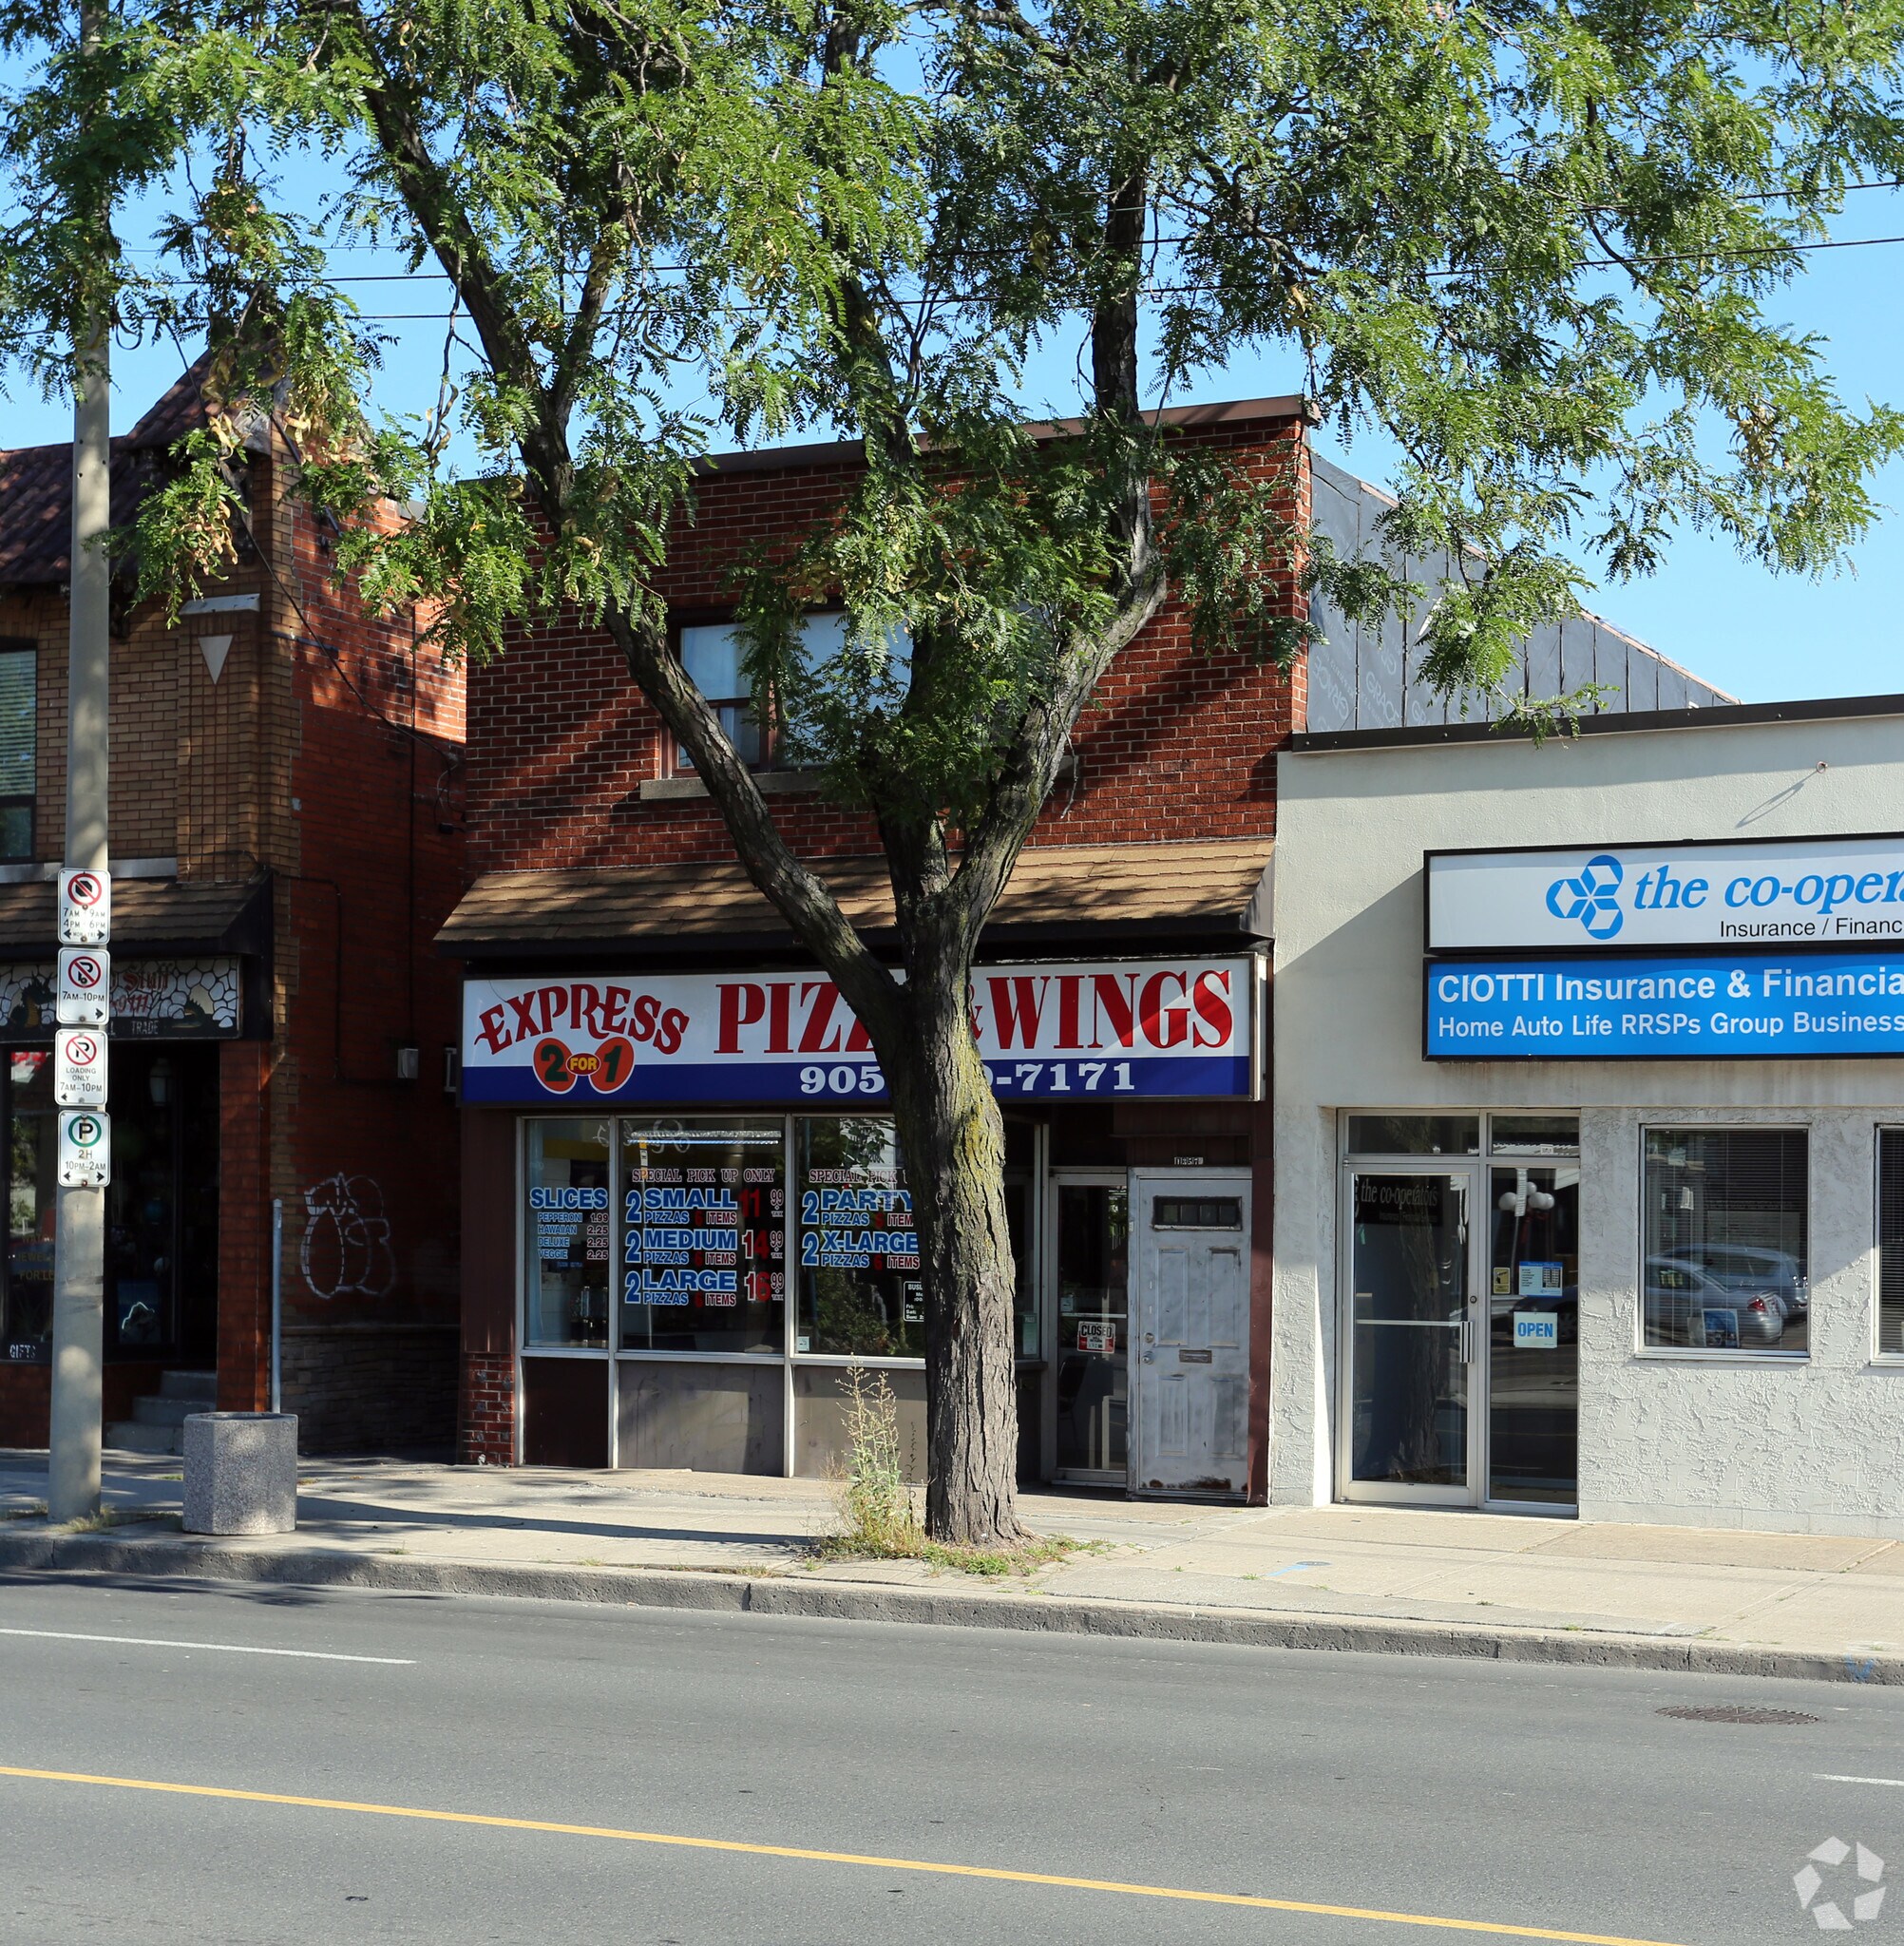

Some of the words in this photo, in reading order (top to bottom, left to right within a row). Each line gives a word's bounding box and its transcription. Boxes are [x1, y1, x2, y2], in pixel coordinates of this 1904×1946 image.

[1633, 865, 1708, 909] the
[63, 907, 80, 917] 7AM
[63, 918, 81, 927] 4PM
[1719, 920, 1816, 938] Insurance
[1819, 919, 1830, 935] /
[1438, 973, 1544, 1003] CIOTTI
[1556, 973, 1715, 1002] Insurance
[1726, 969, 1752, 999] &
[62, 990, 105, 1002] 7AM-10PM
[473, 983, 690, 1056] EXPRESS
[714, 981, 874, 1054] PIZ
[986, 969, 1233, 1050] WINGS
[131, 1020, 160, 1035] TRADE
[1438, 1016, 1504, 1038] Home
[1511, 1016, 1564, 1038] Auto
[1572, 1015, 1612, 1037] Life
[1621, 1013, 1701, 1036] RRSPs
[1710, 1012, 1784, 1039] Group
[1793, 1010, 1904, 1033] Business
[540, 1043, 569, 1082] 2
[570, 1057, 598, 1071] FOR
[604, 1044, 623, 1083] 1
[60, 1082, 103, 1093] 7AM-10PM
[799, 1065, 885, 1094] 905
[632, 1168, 683, 1183] SPECIAL
[686, 1168, 715, 1183] PICK
[720, 1168, 739, 1183] UP
[743, 1168, 775, 1183] ONLY
[809, 1169, 862, 1183] SPECIAL
[867, 1169, 898, 1183] PICK
[1361, 1177, 1378, 1203] the
[529, 1187, 608, 1210] SLICES
[625, 1190, 642, 1223] 2
[643, 1188, 738, 1210] SMALL
[738, 1189, 760, 1218] 11
[770, 1189, 784, 1207] 99
[802, 1190, 819, 1225] 2
[820, 1189, 912, 1211] PARTY
[538, 1211, 583, 1223] PEPPERONI
[590, 1212, 608, 1223] 1.99
[643, 1210, 690, 1225] PIZZAS
[706, 1211, 737, 1225] ITEMS
[821, 1211, 869, 1226] PIZZAS
[887, 1212, 914, 1227] ITEM
[538, 1224, 578, 1234] HAWAIIAN
[587, 1226, 608, 1235] 2.25
[538, 1236, 570, 1247] DELUXE
[587, 1237, 608, 1248] 2.25
[625, 1230, 641, 1264] 2
[642, 1228, 738, 1250] MEDIUM
[741, 1229, 770, 1261] 14
[770, 1230, 784, 1249] 99
[802, 1231, 819, 1266] 2
[820, 1231, 920, 1254] X-LARGE
[538, 1249, 568, 1260] VEGGIE
[587, 1250, 608, 1260] 2.25
[643, 1250, 689, 1265] PIZZAS
[705, 1251, 736, 1266] ITEMS
[821, 1254, 869, 1268] PIZZAS
[887, 1254, 921, 1269] ITEMS
[624, 1269, 641, 1304] 2
[642, 1269, 738, 1292] LARGE
[744, 1270, 771, 1302] 16
[770, 1272, 784, 1290] 99
[642, 1291, 689, 1306] PIZZAS
[705, 1292, 736, 1307] ITEMS
[1081, 1325, 1113, 1338] CLOSED
[1517, 1322, 1553, 1338] OPEN
